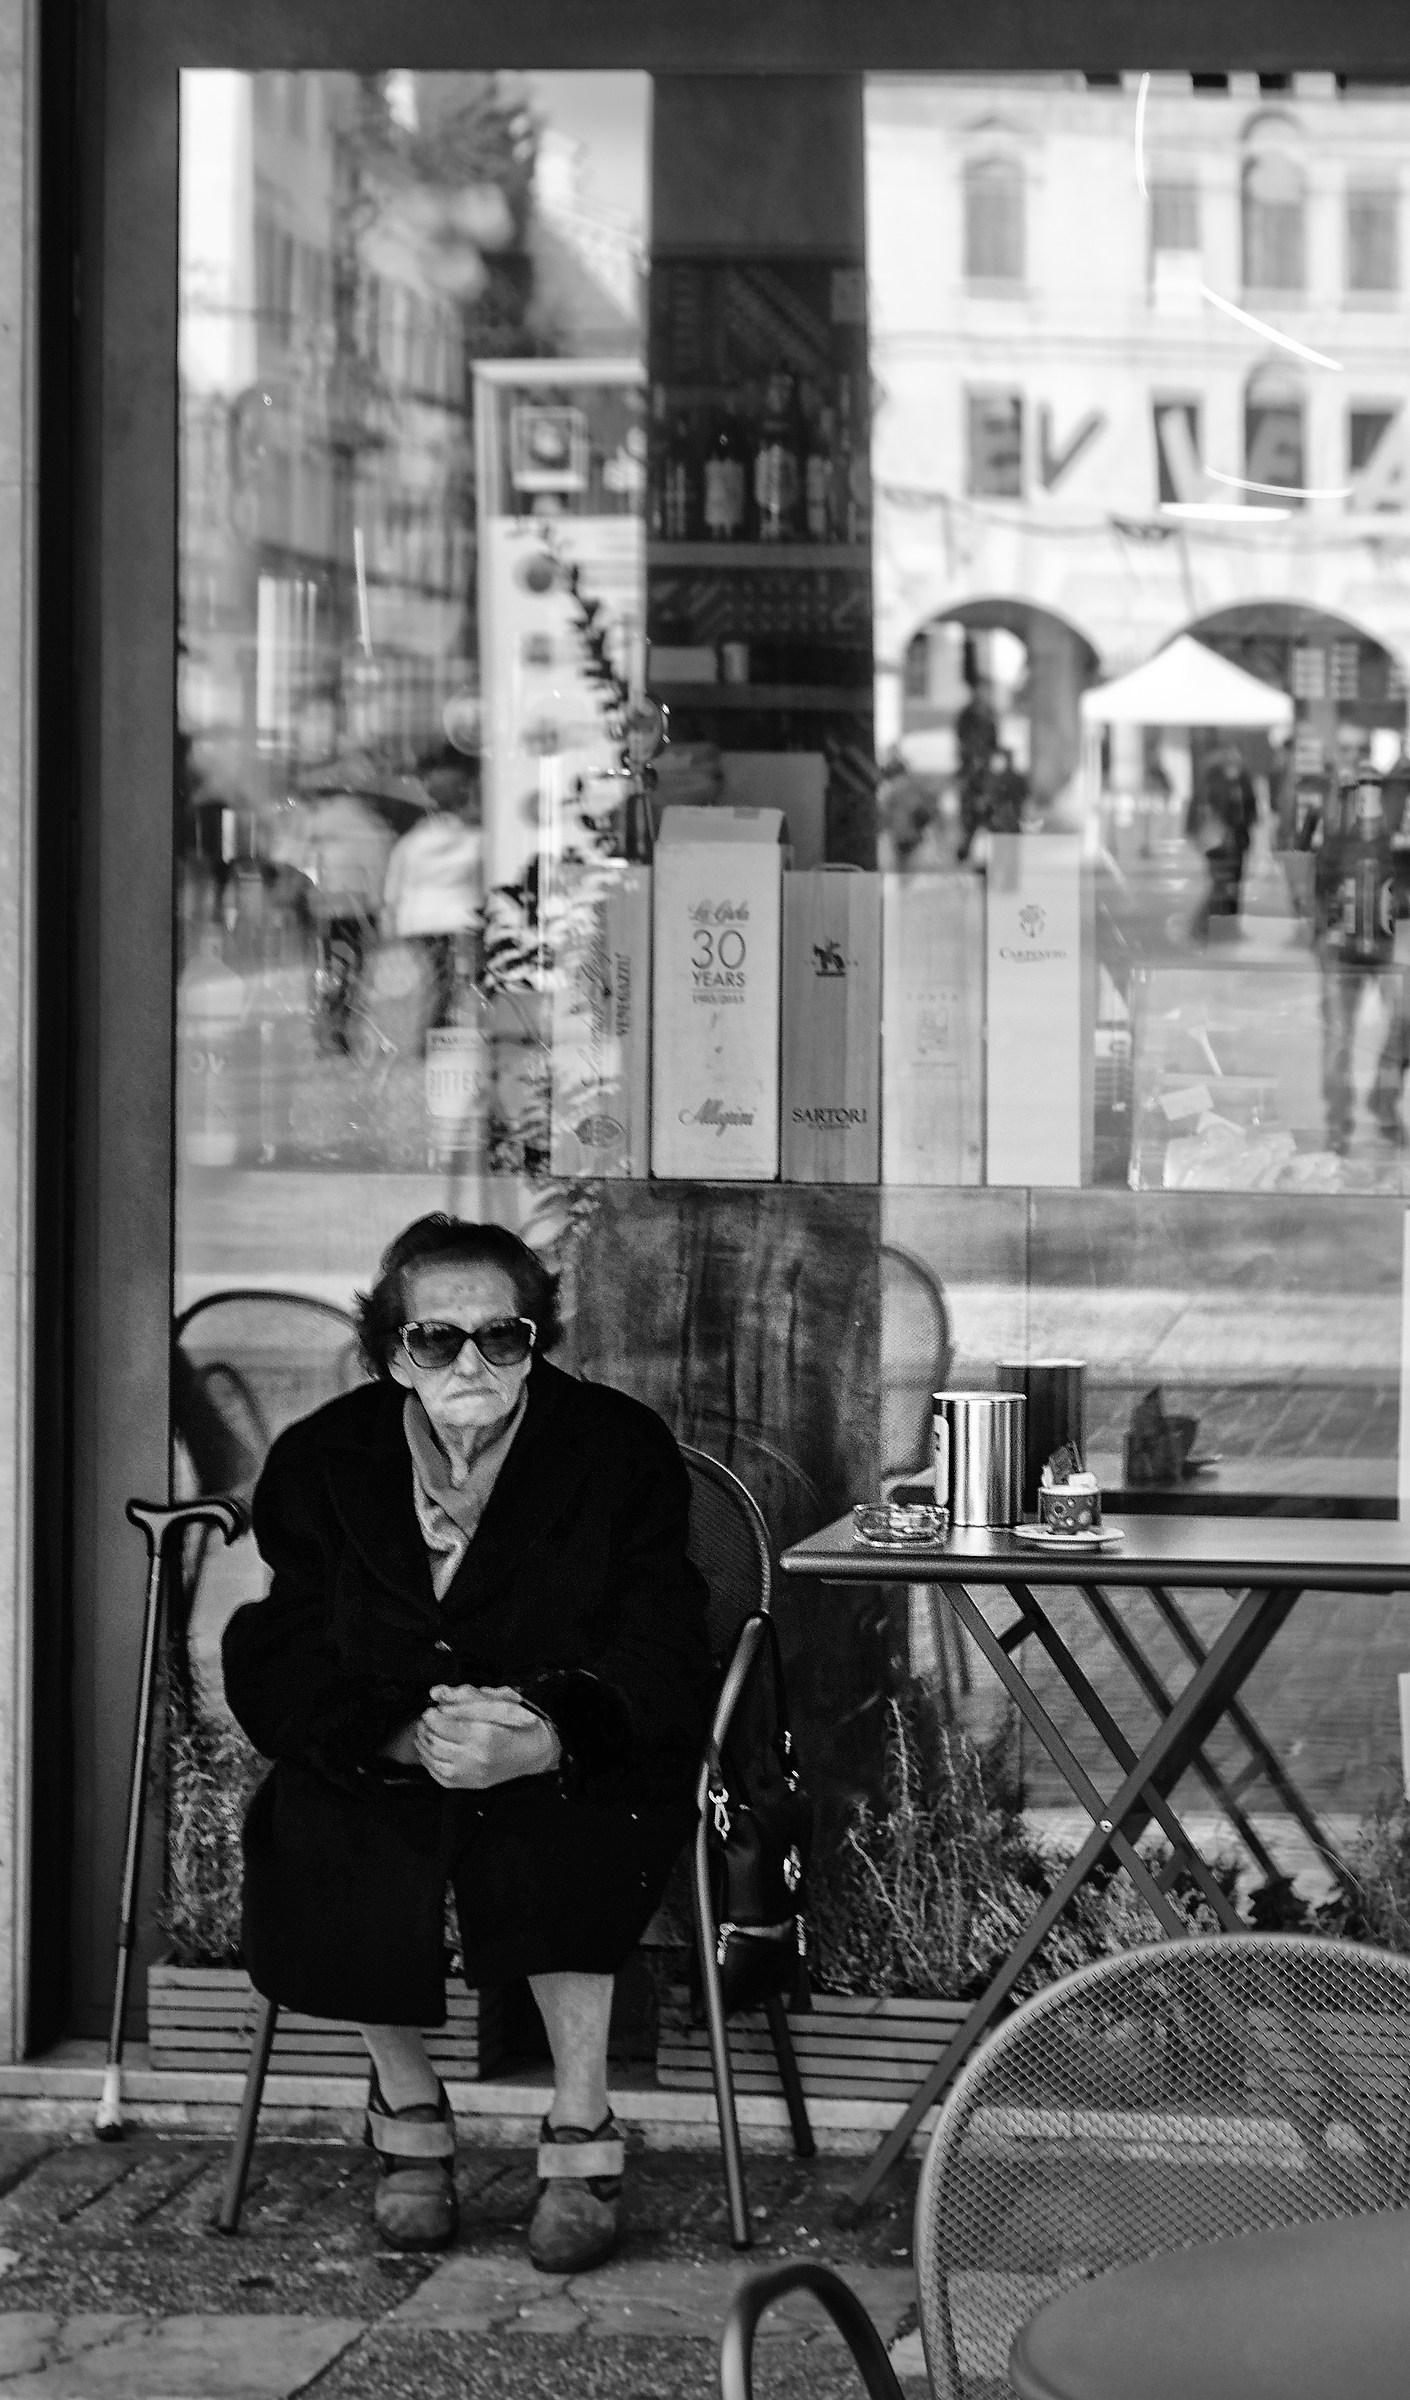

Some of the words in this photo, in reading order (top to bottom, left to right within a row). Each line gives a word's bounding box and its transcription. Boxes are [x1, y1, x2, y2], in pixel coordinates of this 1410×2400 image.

[692, 929, 746, 969] 30
[692, 971, 745, 987] YEARS
[792, 1107, 867, 1124] SARTORI
